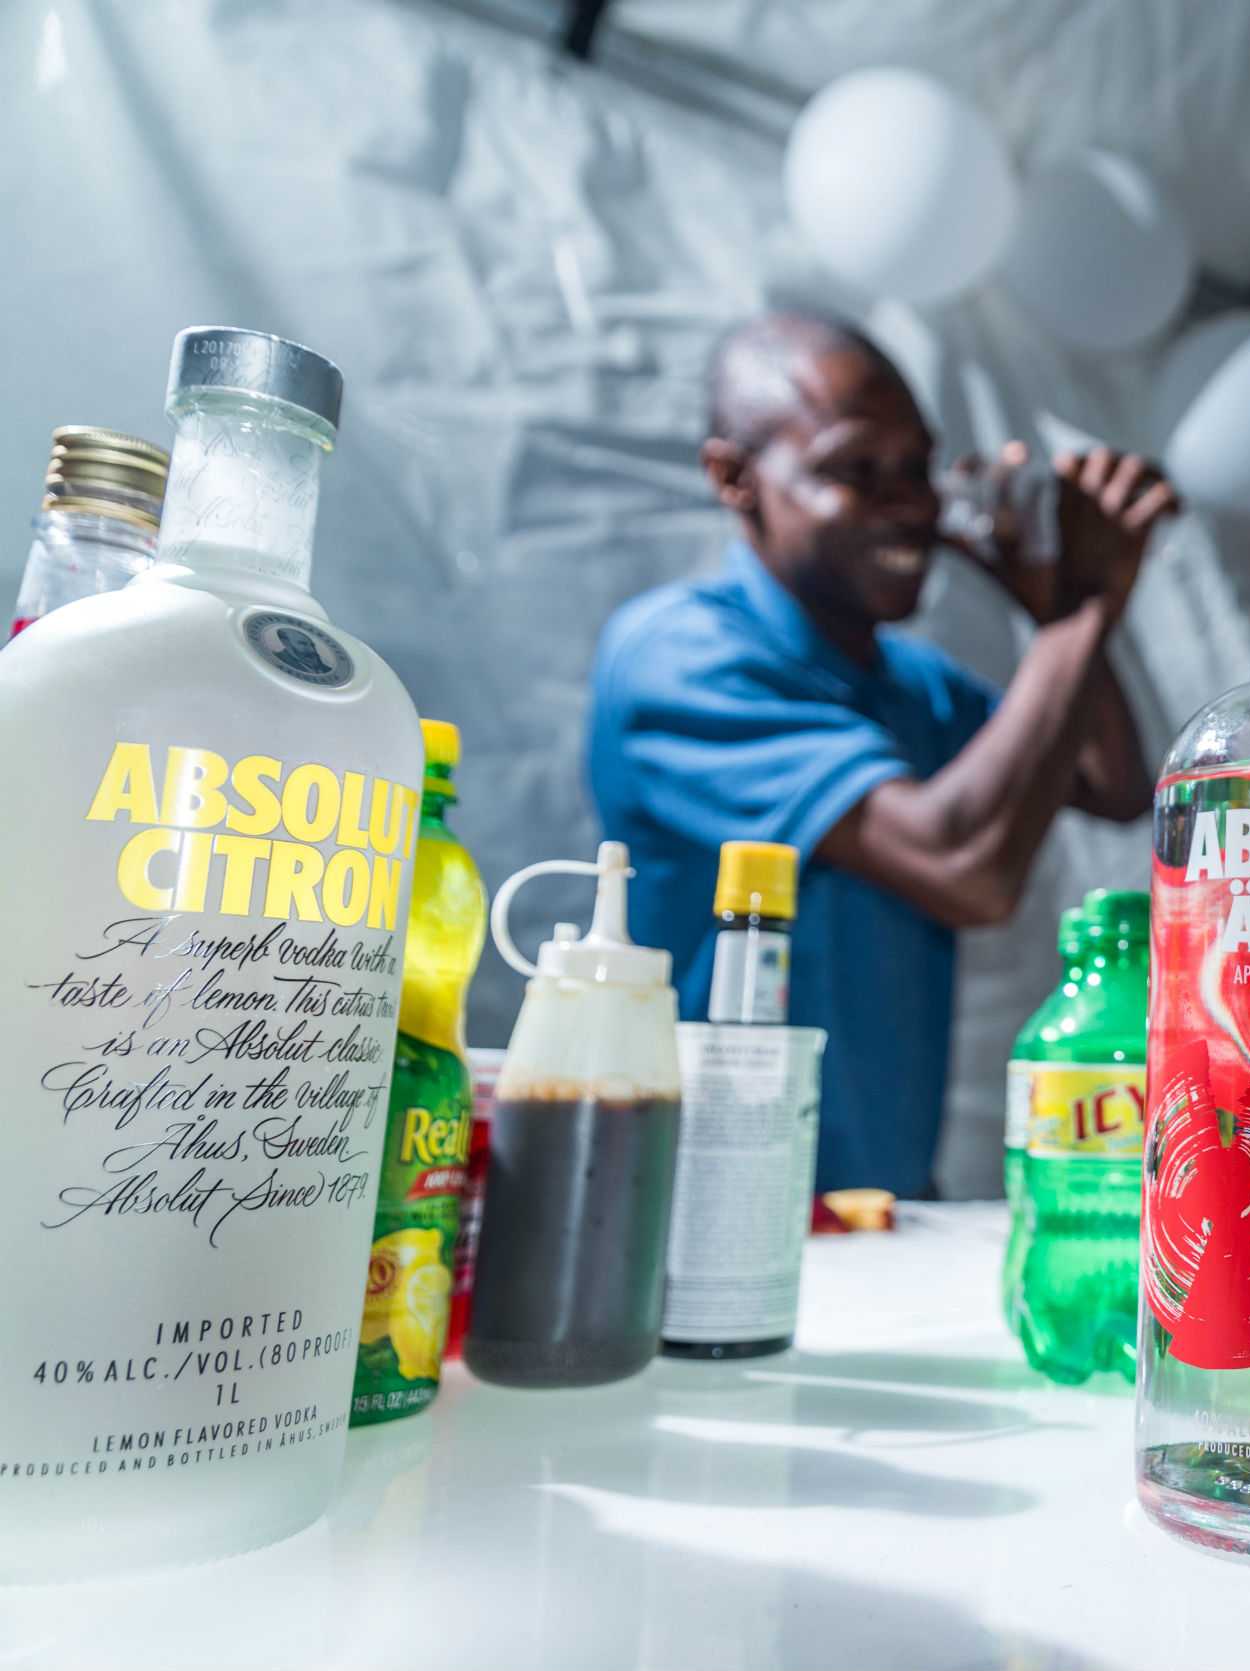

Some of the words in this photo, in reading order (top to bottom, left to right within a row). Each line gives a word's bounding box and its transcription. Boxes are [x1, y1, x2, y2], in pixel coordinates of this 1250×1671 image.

[85, 742, 420, 860] ABSOLUT
[117, 827, 402, 931] CITRON
[75, 914, 183, 959] A
[155, 922, 286, 971] superb
[279, 929, 346, 968] vodka
[350, 935, 392, 973] with
[25, 973, 132, 1008] taste
[273, 975, 341, 1017] This
[82, 1030, 143, 1057] is
[146, 1036, 190, 1058] an
[186, 1020, 323, 1064] Absolut
[40, 1061, 204, 1131] Crafted
[207, 1083, 242, 1110] in
[243, 1067, 291, 1111] the
[295, 1070, 366, 1133] village
[40, 1168, 234, 1229] Absolut
[155, 1309, 303, 1346] IMPORTED
[216, 1382, 240, 1407] 1L
[92, 1430, 165, 1454] LEMON
[173, 1416, 268, 1448] FLAVORED
[274, 1404, 318, 1429] VODKA
[0, 1460, 108, 1478] PRODUCED
[118, 1455, 157, 1473] AND
[167, 1443, 249, 1468] BOTTLED
[257, 1438, 273, 1452] IN
